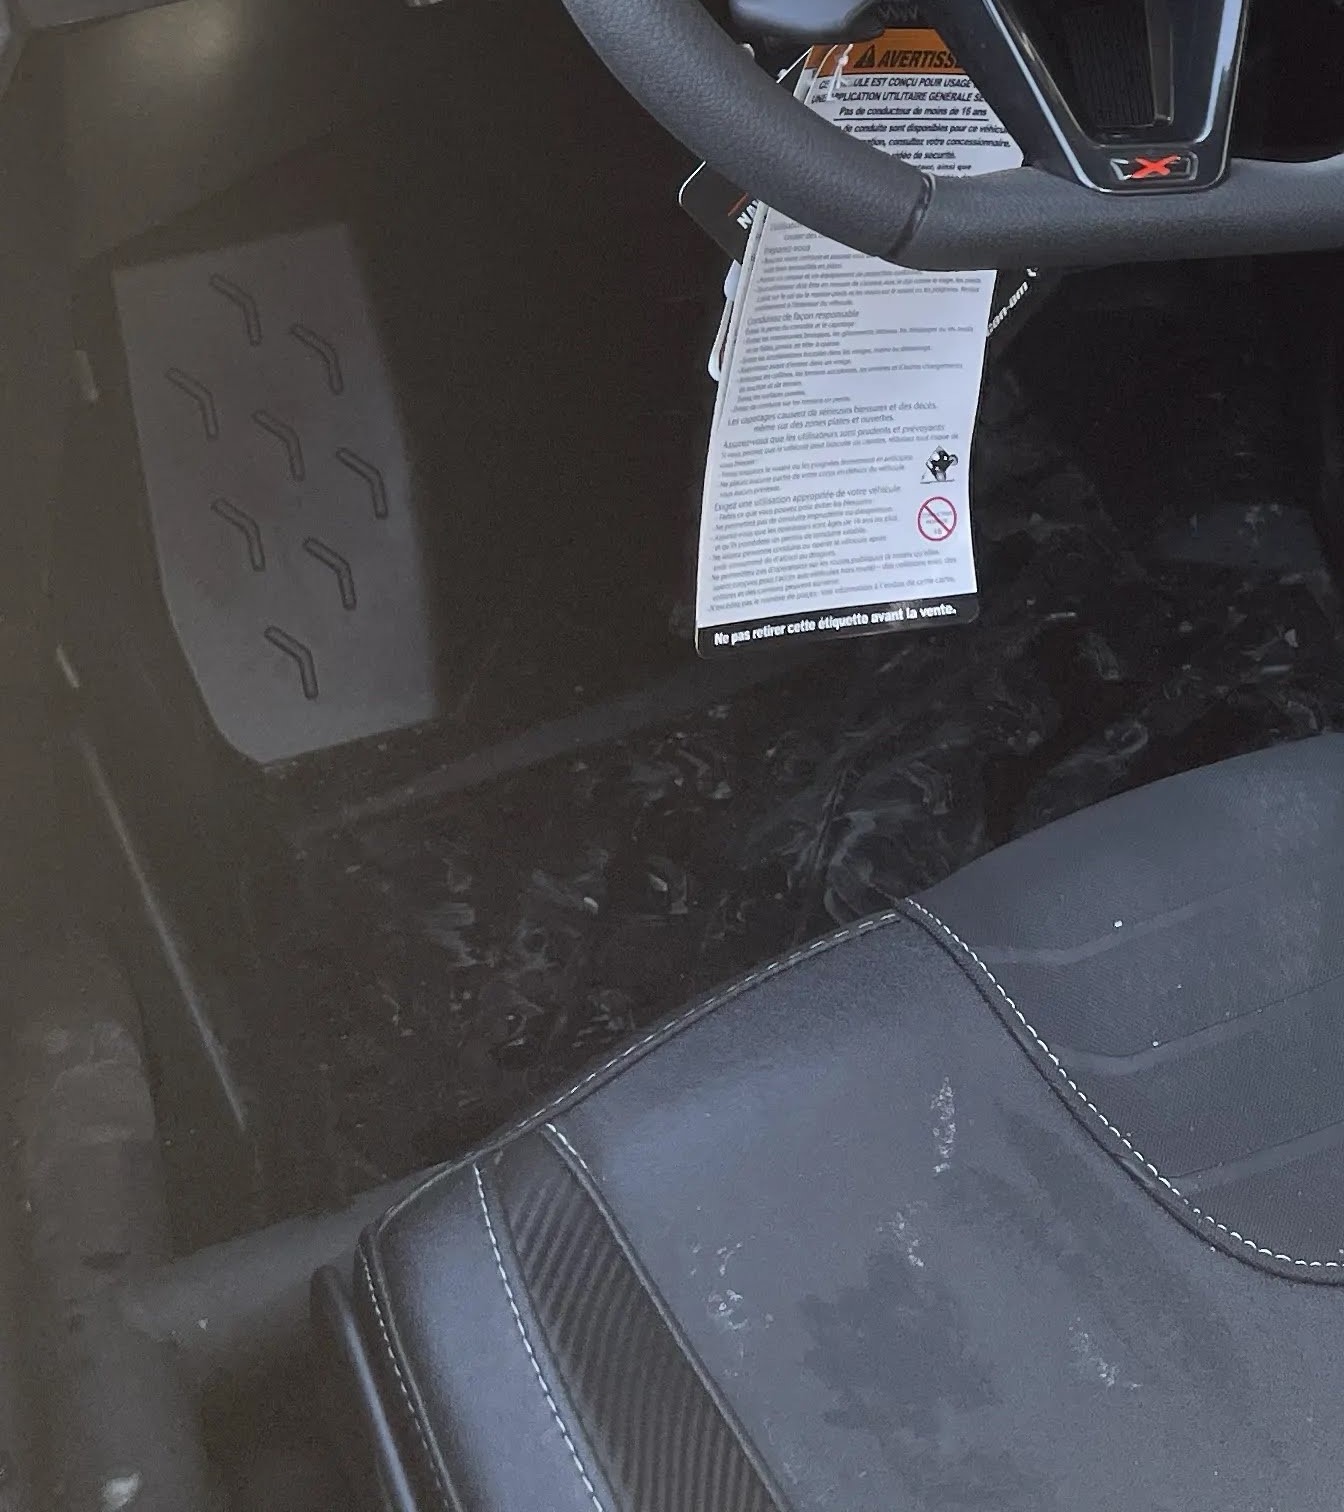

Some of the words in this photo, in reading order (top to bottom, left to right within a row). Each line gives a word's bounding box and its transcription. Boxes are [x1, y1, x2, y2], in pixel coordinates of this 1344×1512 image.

[877, 49, 958, 69] AVERTISS
[919, 78, 942, 87] POUR
[714, 632, 730, 645] Ne
[731, 630, 750, 645] pas
[752, 624, 786, 639] retirer
[787, 618, 816, 634] cette
[818, 612, 868, 631] étiquette
[870, 608, 904, 624] avant
[906, 606, 917, 619] la
[919, 603, 957, 618] vente.
